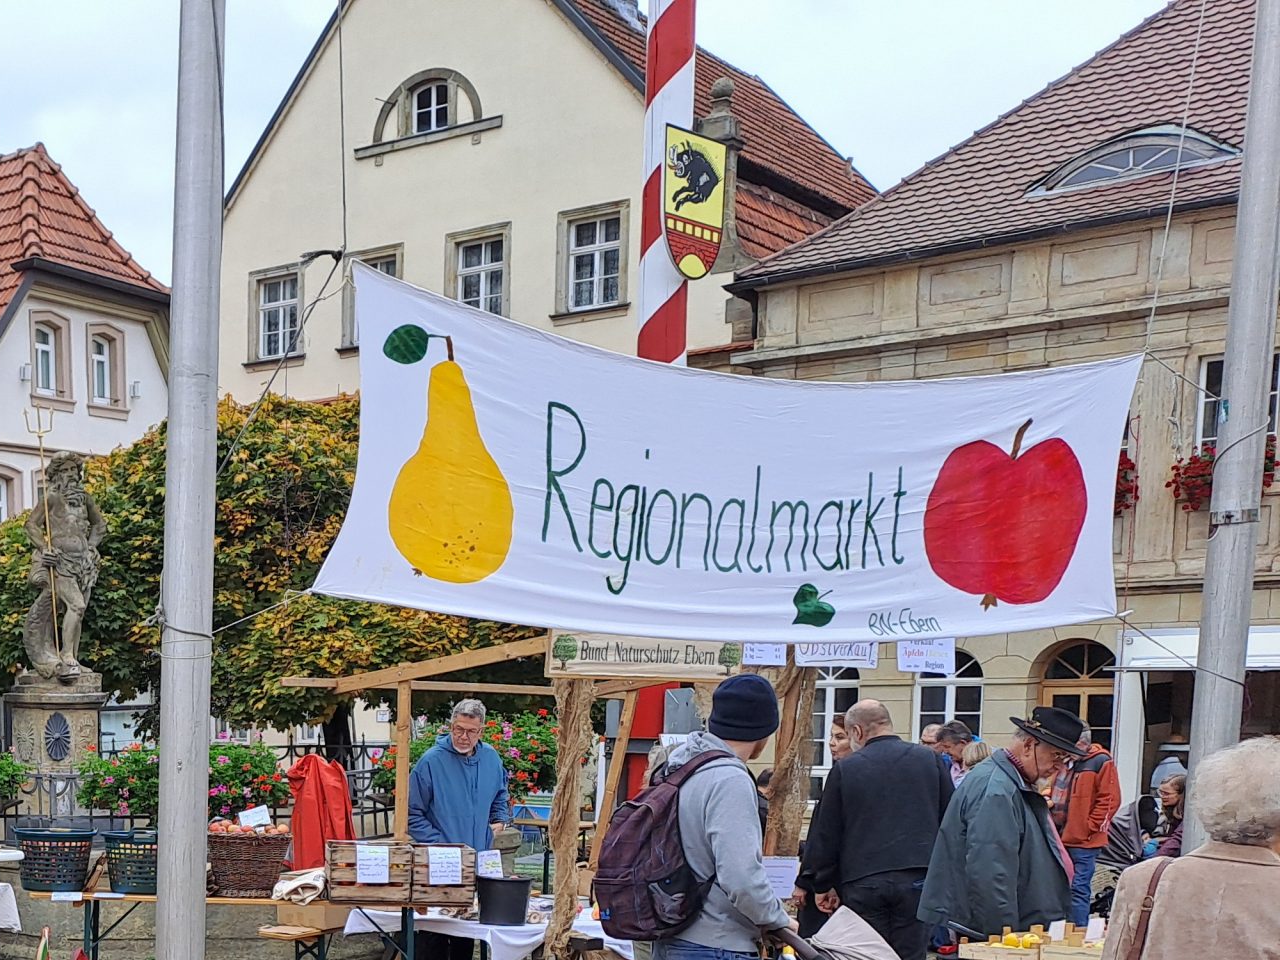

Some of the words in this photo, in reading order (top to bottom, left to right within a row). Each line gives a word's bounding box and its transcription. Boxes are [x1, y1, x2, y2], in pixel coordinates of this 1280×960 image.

[542, 401, 904, 595] Regionalmarkt
[868, 607, 942, 636] BN-Ebern
[580, 640, 609, 661] Bund
[614, 641, 679, 664] Naturschutz
[684, 644, 715, 665] Ebern
